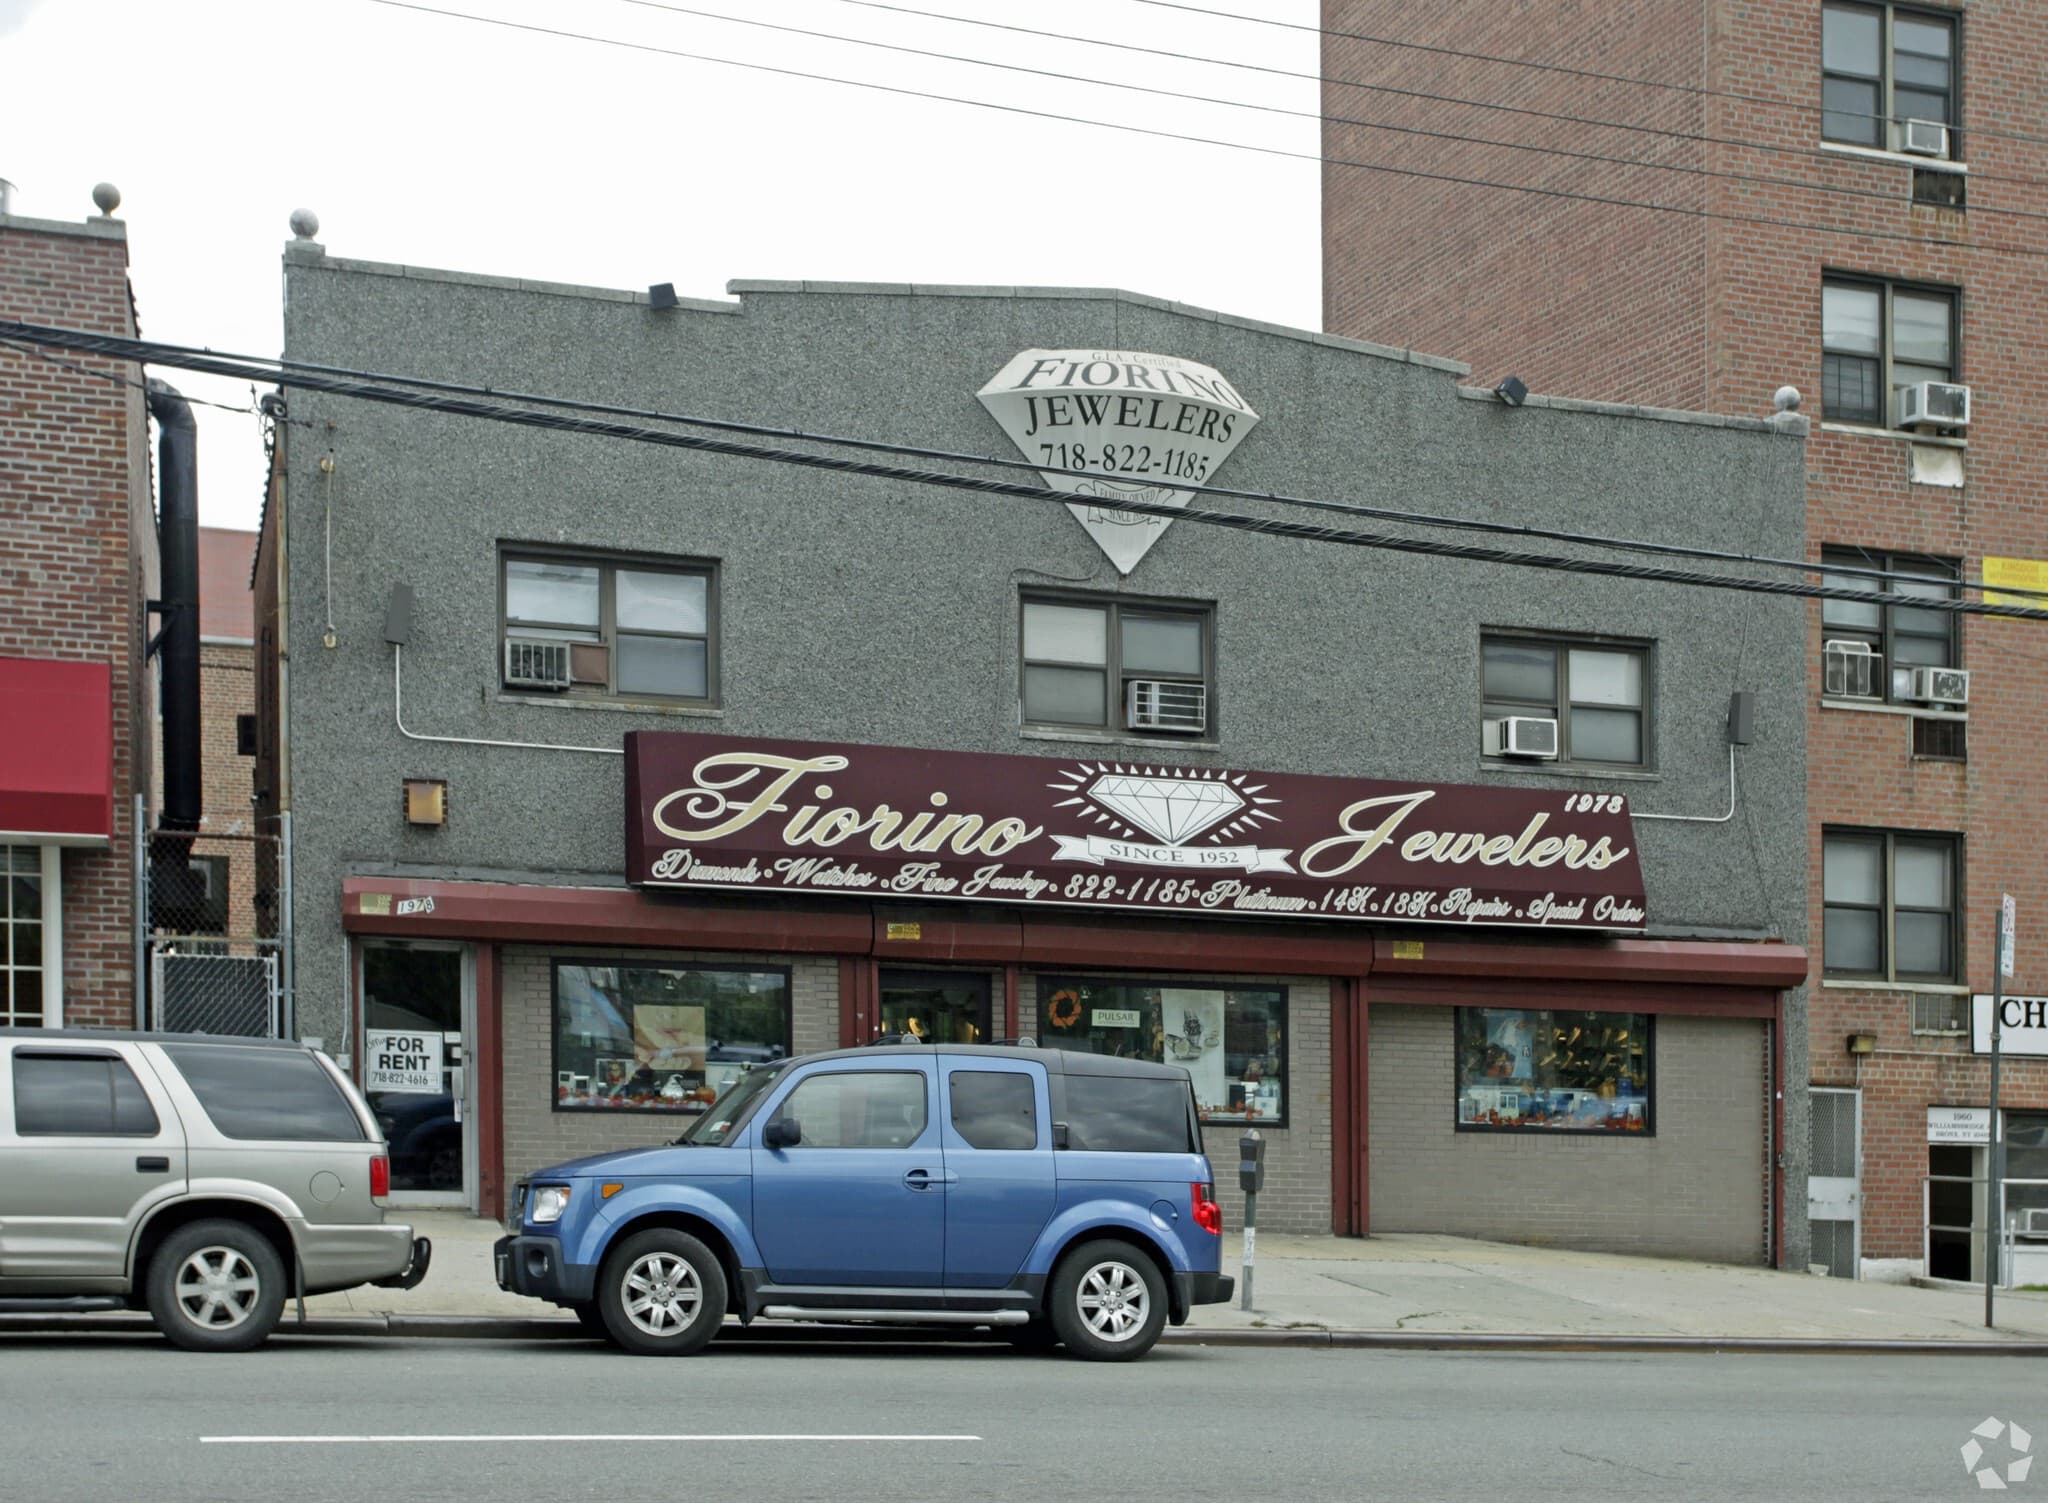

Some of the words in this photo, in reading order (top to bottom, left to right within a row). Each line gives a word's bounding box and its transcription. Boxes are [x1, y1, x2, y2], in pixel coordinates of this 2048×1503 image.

[1009, 357, 1244, 411] FIORINO
[1024, 394, 1236, 443] JEWELERS
[1040, 443, 1210, 482] 718-822-1185
[1564, 793, 1624, 814] 1978
[652, 751, 1043, 857] Fiorino
[1300, 790, 1630, 878] Jewelers
[1109, 843, 1184, 863] SINCE
[1198, 851, 1240, 864] 1952
[651, 849, 761, 883] Diamonds
[774, 857, 878, 888] Watches
[891, 862, 959, 892] Fine
[961, 864, 1049, 899] Jewelry
[1064, 874, 1195, 904] 822-1185
[1200, 879, 1309, 911] Platinum
[1320, 886, 1376, 914] 14K
[1382, 891, 1437, 918] 18K
[1440, 888, 1512, 923] Repairs
[1527, 892, 1587, 925] Special
[1593, 895, 1645, 923] Orders
[400, 898, 434, 913] 1978
[1098, 1011, 1134, 1021] PULSAR
[386, 1036, 424, 1053] FOR
[379, 1054, 431, 1071] RENT
[1953, 1112, 1973, 1121] 1960
